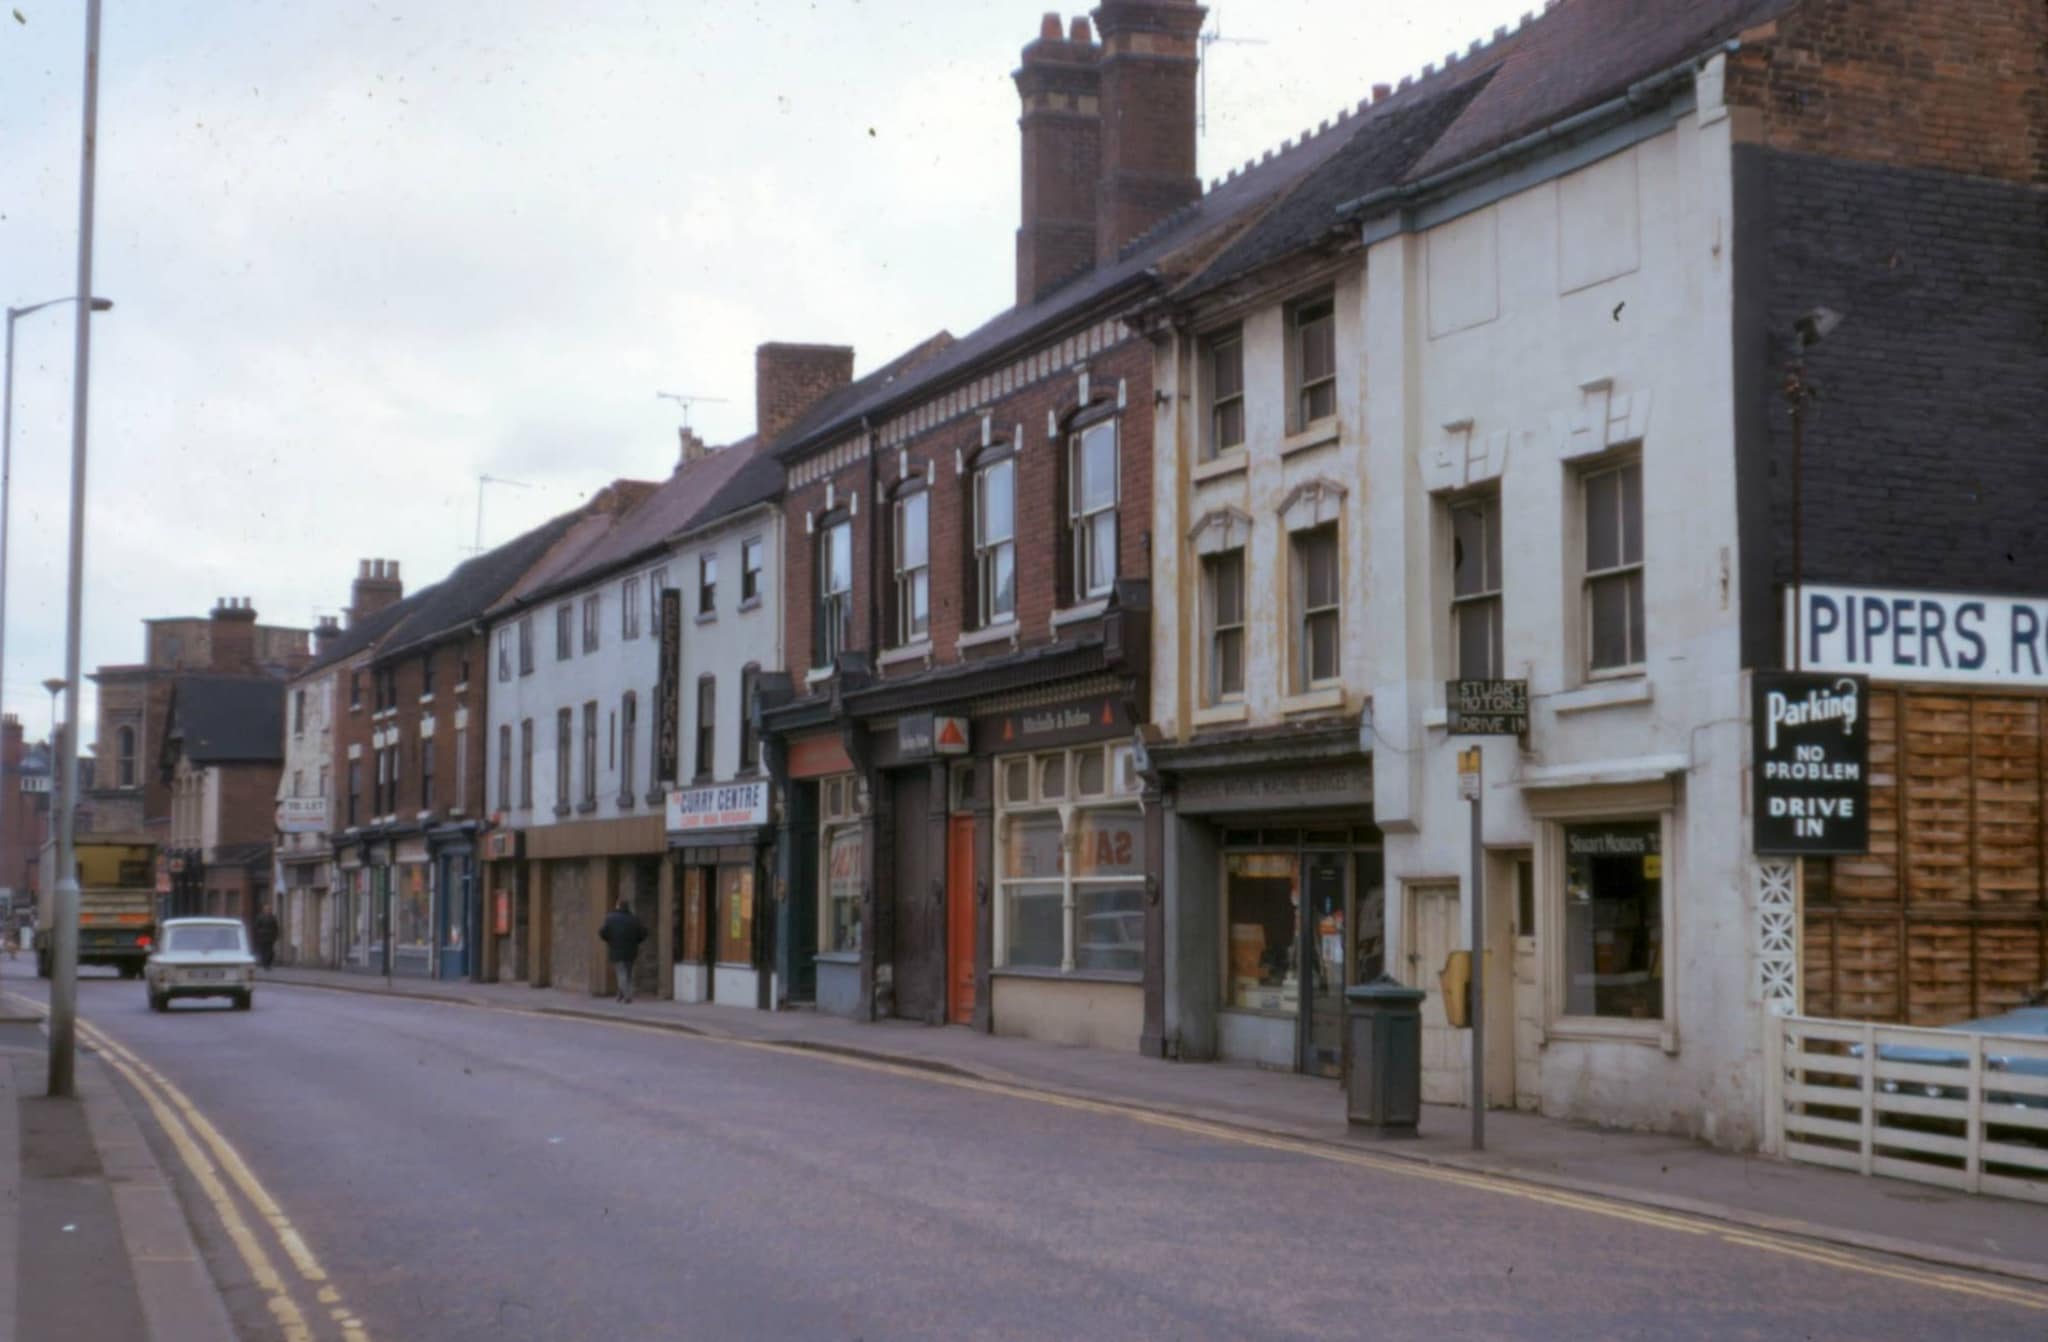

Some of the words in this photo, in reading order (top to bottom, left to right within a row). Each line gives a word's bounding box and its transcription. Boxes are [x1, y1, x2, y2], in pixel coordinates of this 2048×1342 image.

[1810, 594, 1987, 670] PIPERS
[2011, 604, 2048, 675] R
[1461, 681, 1527, 697] STUART
[1461, 696, 1526, 711] MOTORS
[1461, 716, 1504, 733] DRIVE
[1511, 716, 1528, 733] IN
[1795, 745, 1825, 762] NO
[1765, 762, 1860, 780] PROBLEM
[681, 790, 714, 814] CURRY
[717, 784, 759, 811] CENTRE
[1769, 797, 1854, 817] DRIVE
[1796, 818, 1824, 837] IN
